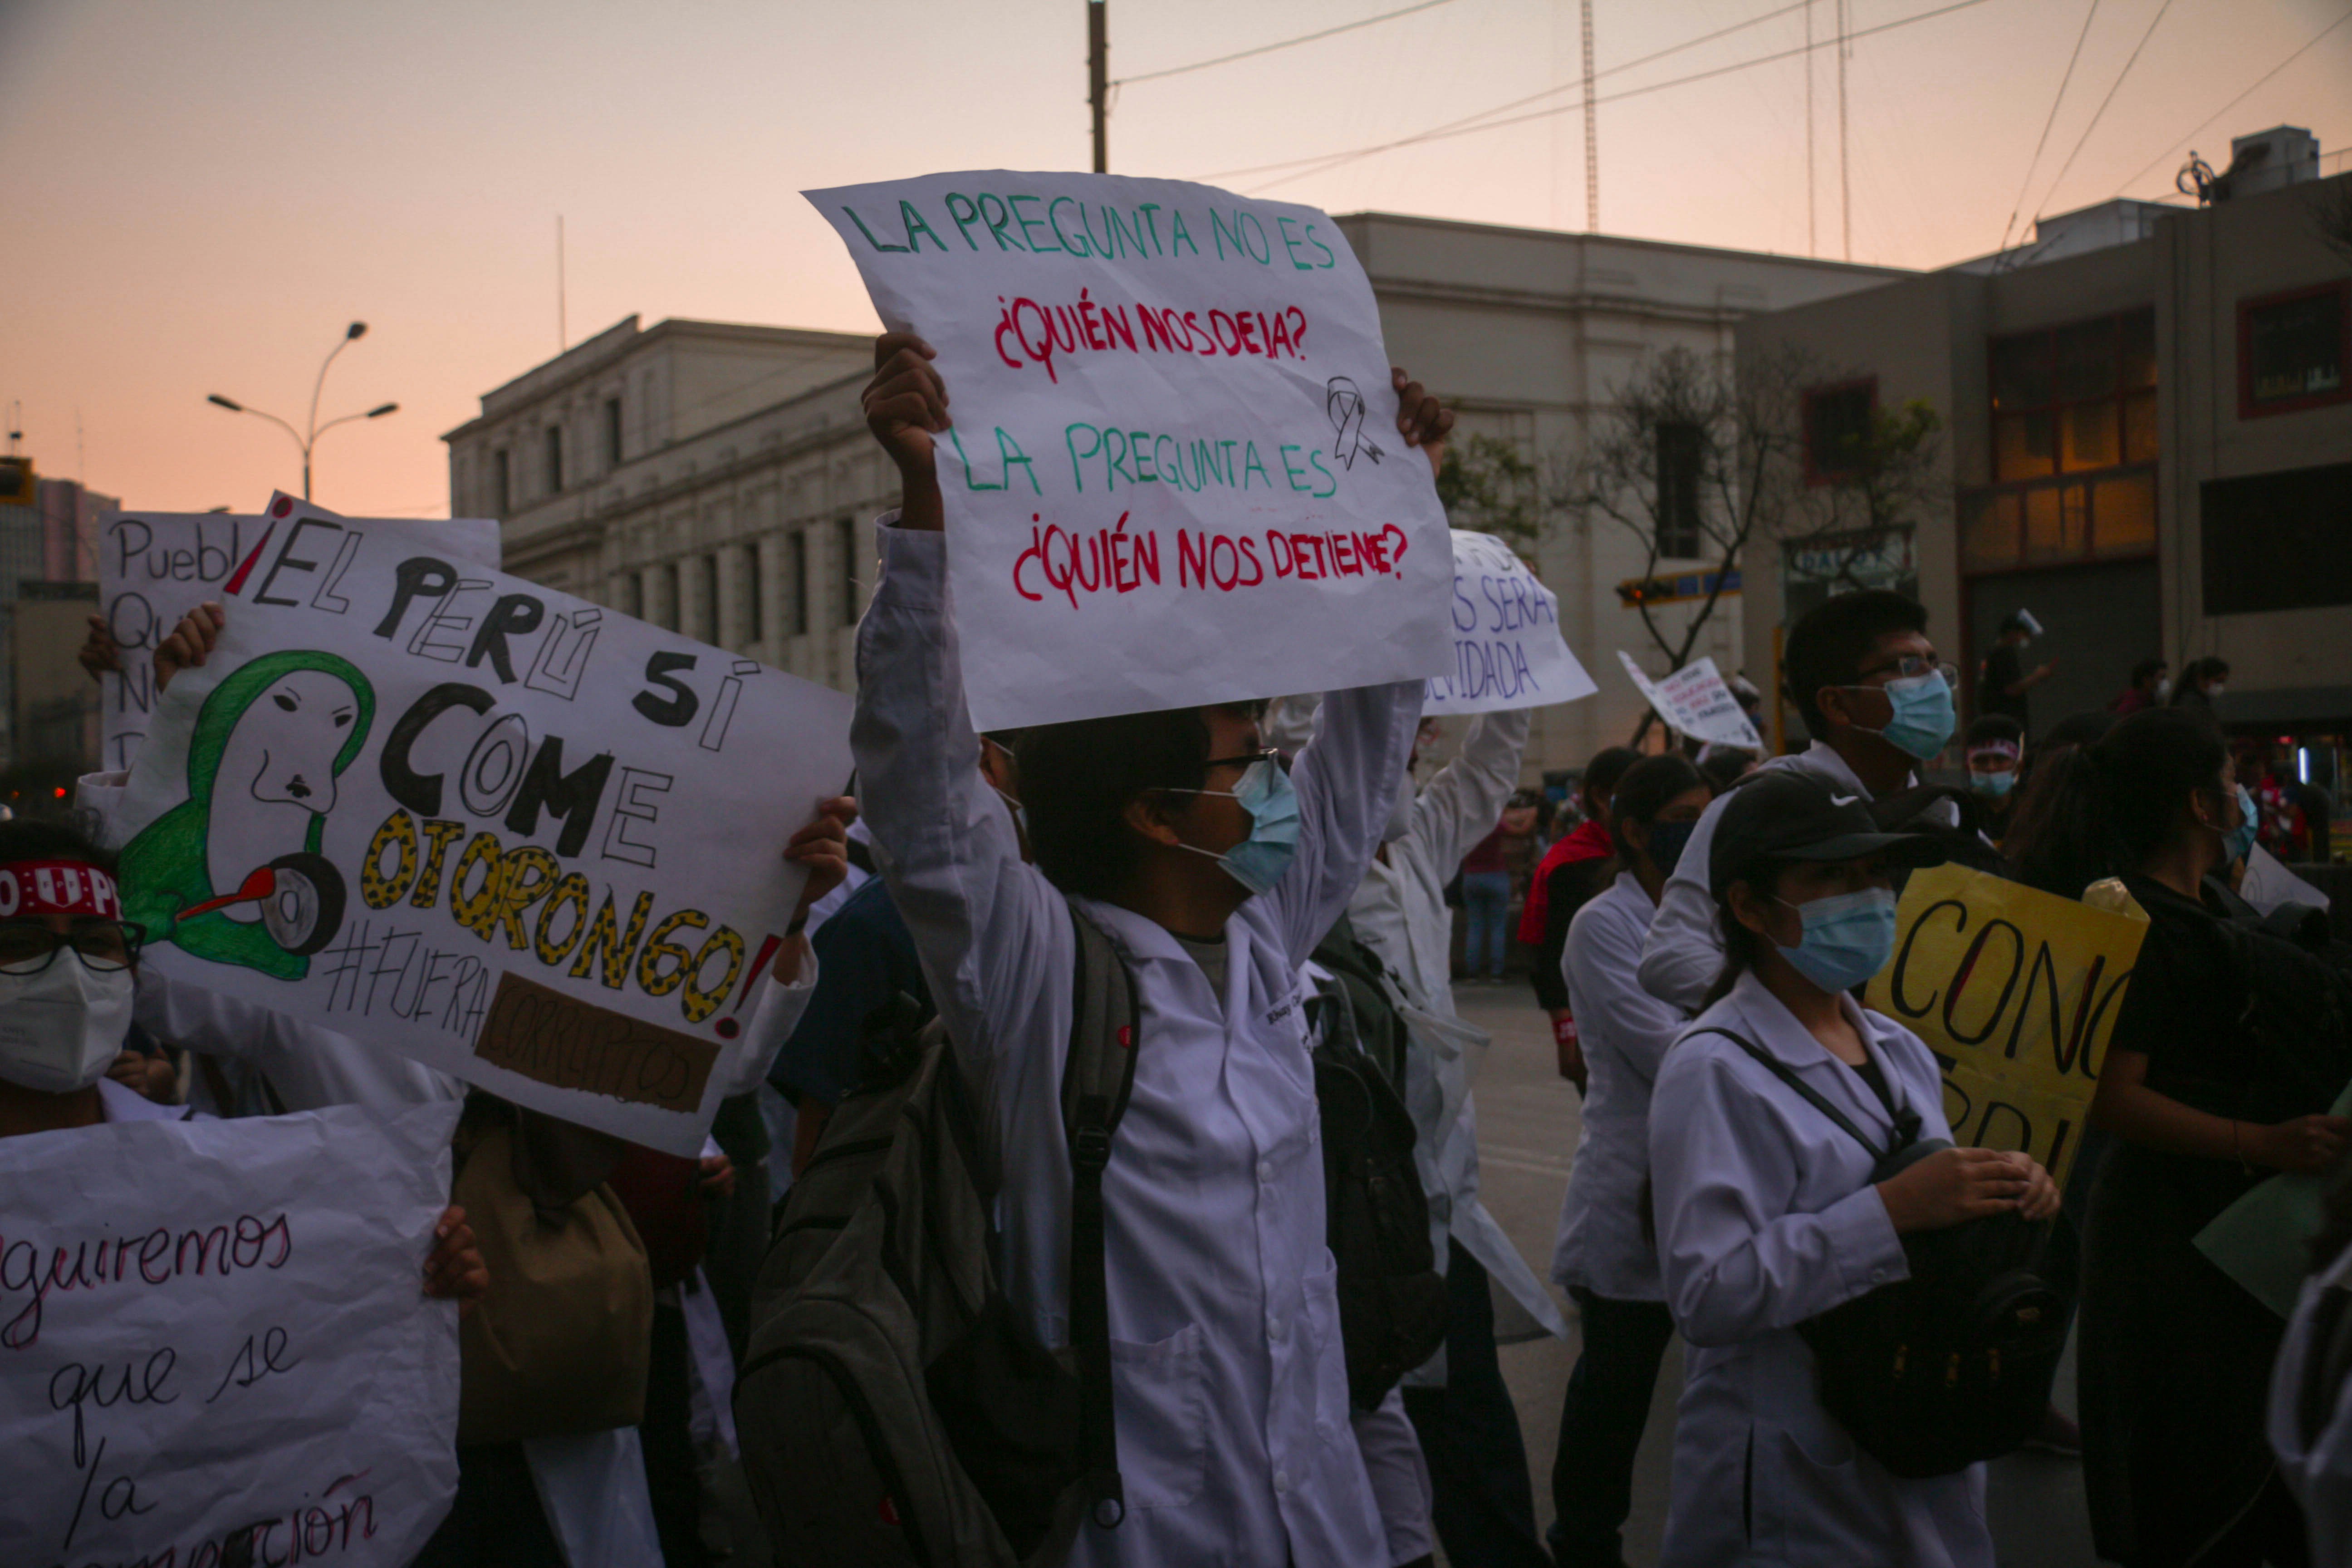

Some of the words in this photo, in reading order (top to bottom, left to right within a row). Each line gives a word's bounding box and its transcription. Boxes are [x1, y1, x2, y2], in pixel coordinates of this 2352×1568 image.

[842, 199, 948, 255] LA
[945, 192, 1199, 261] PREGUNTA
[1209, 206, 1271, 266] NO
[1281, 216, 1336, 271] ES
[994, 287, 1137, 384] ¿QUIÉN
[948, 425, 1043, 497] LA
[1065, 422, 1272, 495] PREGUNTA
[1280, 442, 1338, 500] ES
[1012, 509, 1161, 611] ¿QUIÉN
[1177, 531, 1265, 592] NOS
[1265, 523, 1409, 582] DETIENE?
[1481, 574, 1554, 633] SERA
[373, 556, 602, 701] PERÚ
[632, 650, 761, 752] SÍ
[379, 681, 674, 869] COME
[362, 807, 782, 1039] OTORONGO!
[323, 919, 491, 1047] #FUERA
[488, 986, 690, 1103] CORRUPTOS
[49, 1347, 180, 1469] que
[205, 1326, 305, 1405] se
[63, 1436, 161, 1550] la
